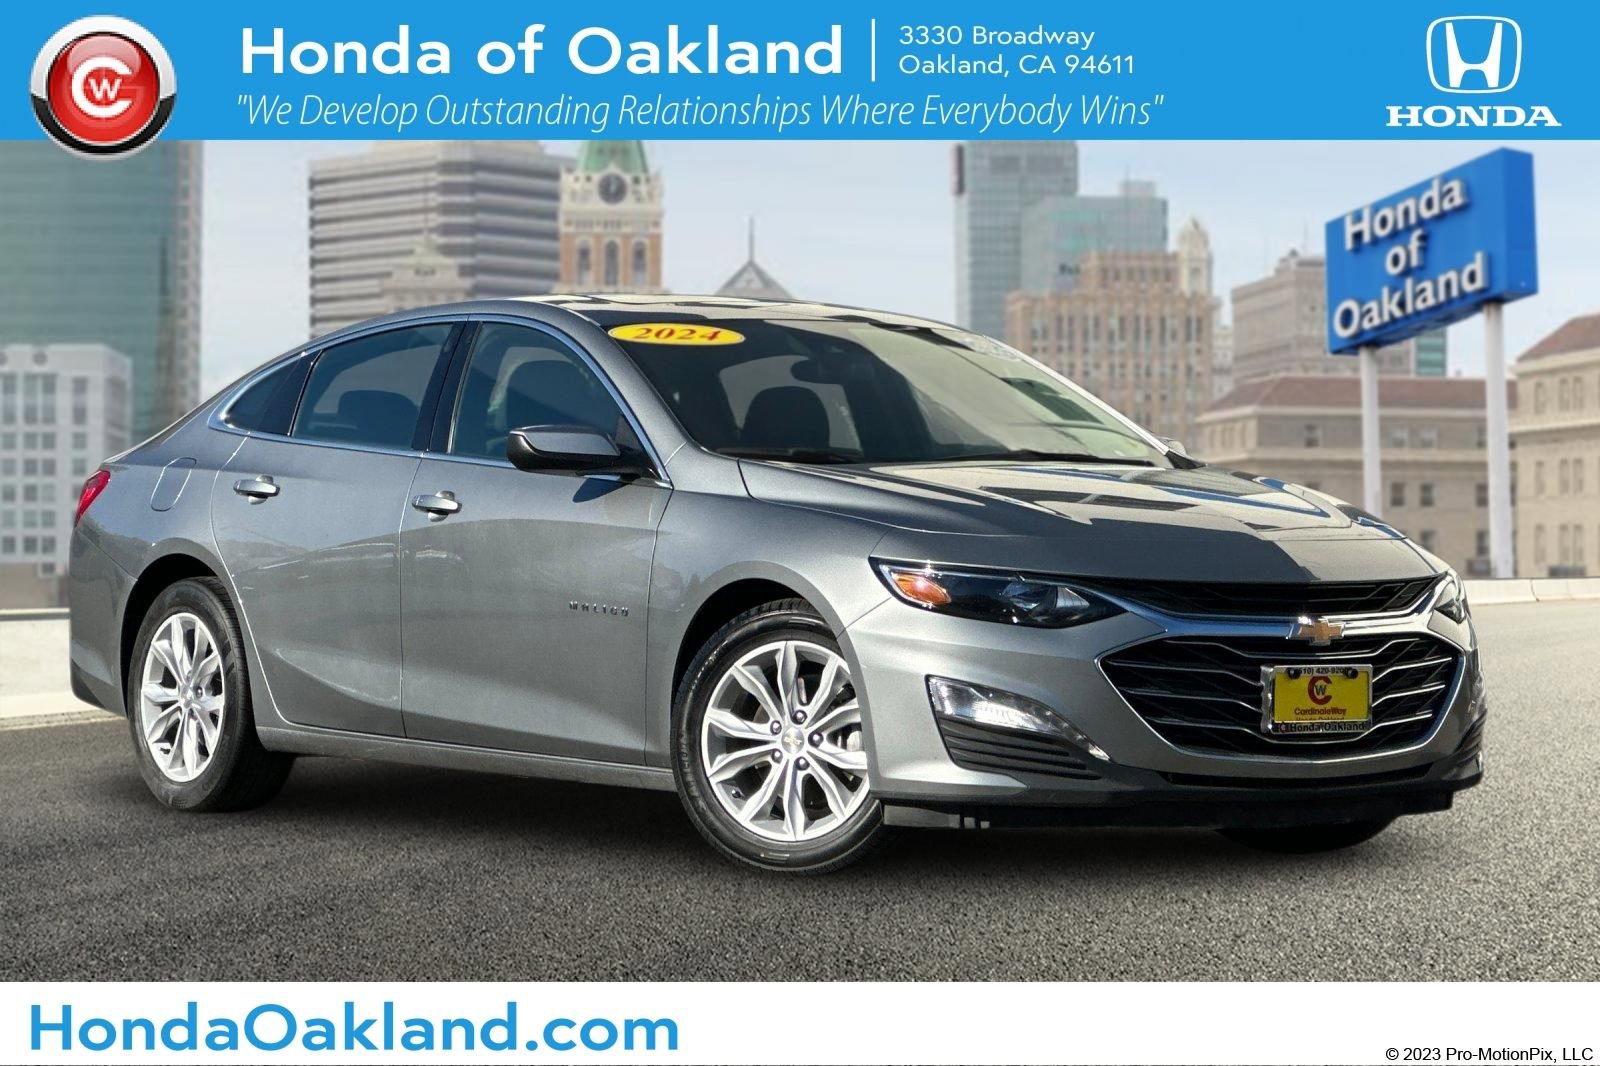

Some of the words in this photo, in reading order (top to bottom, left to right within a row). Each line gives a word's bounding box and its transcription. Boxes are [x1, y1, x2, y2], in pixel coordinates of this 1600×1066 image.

[1343, 177, 1468, 250] Honda
[1385, 229, 1424, 276] of
[1333, 251, 1489, 338] Oakland
[634, 328, 721, 341] 2024
[1290, 723, 1321, 732] Honda
[1324, 721, 1365, 731] Oakland
